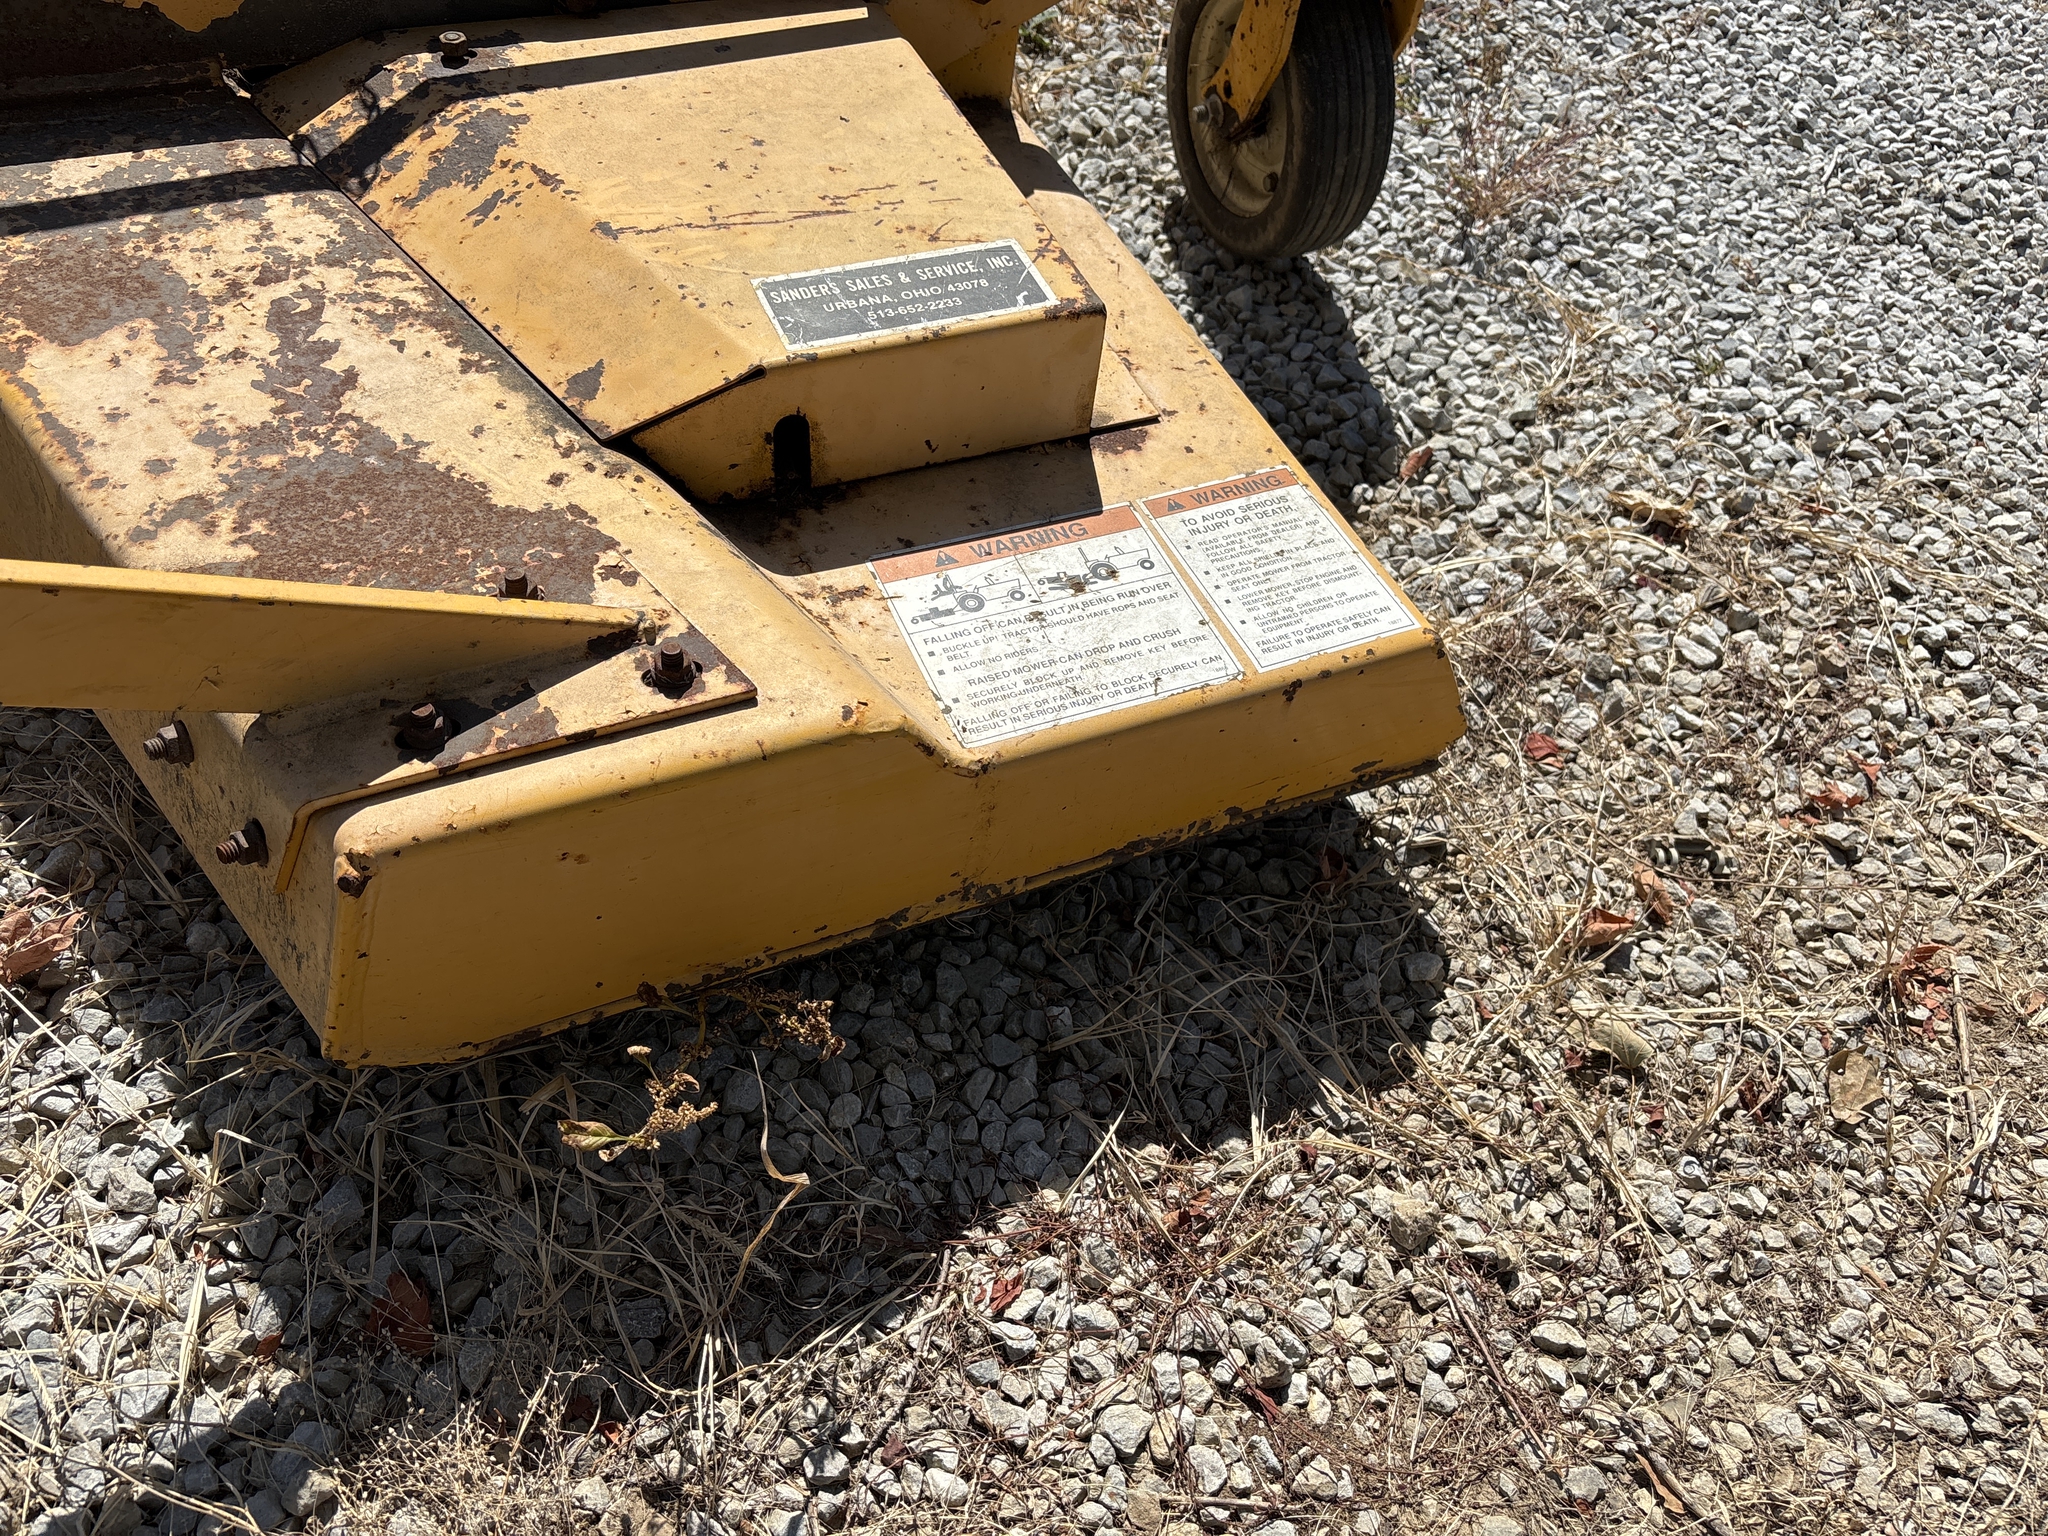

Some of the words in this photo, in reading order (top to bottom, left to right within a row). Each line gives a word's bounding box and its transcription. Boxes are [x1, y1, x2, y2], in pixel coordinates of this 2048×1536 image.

[769, 281, 840, 303] SANDERS
[845, 273, 892, 291] SALES
[897, 271, 911, 283] &
[915, 258, 983, 280] SERVICE,
[822, 294, 897, 312] URBANA,
[900, 286, 941, 299] OHIO
[947, 278, 989, 291] 43078
[867, 297, 962, 321] 513-652-2233
[1188, 475, 1282, 504] WARNING
[1179, 517, 1197, 527] TO
[1201, 508, 1235, 522] AVOID
[1237, 495, 1288, 513] SERIOUS
[1187, 519, 1229, 536] INJURY
[1233, 513, 1252, 524] OR
[968, 522, 1089, 558] WARNING
[1197, 537, 1218, 546] READ
[1221, 524, 1269, 540] OPERATOR'S
[1271, 517, 1302, 527] MANUAL
[1201, 537, 1245, 553] (AVAILABLE
[1247, 531, 1268, 540] FROM
[1269, 523, 1302, 535] DEALER)
[1304, 518, 1319, 526] AND
[1205, 546, 1236, 558] FOLLOW
[1254, 535, 1281, 545] SAFETY
[1215, 563, 1235, 572] KEEP
[1253, 549, 1285, 561] SHIELD
[1320, 537, 1335, 545] AND
[1226, 573, 1261, 586] OPERATE
[1261, 565, 1290, 577] MOWER
[1290, 560, 1312, 569] FROM
[1312, 550, 1346, 563] TRACTOR
[1229, 565, 1252, 575] GOOD
[1230, 583, 1250, 592] SEAT
[1236, 589, 1264, 601] LOWER
[1294, 575, 1313, 585] STOP
[1314, 568, 1341, 580] ENGINE
[1342, 564, 1357, 572] AND
[1241, 594, 1273, 606] REMOVE
[1274, 589, 1289, 597] KEY
[1291, 581, 1321, 593] BEFORE
[1322, 570, 1362, 584] DISMOUNT-
[922, 627, 971, 645] FALLING
[973, 622, 994, 633] OFF
[997, 616, 1022, 627] CAN
[1023, 606, 1064, 622] RSULT
[1067, 602, 1080, 611] IN
[1080, 594, 1115, 608] BEING
[1116, 588, 1140, 599] RUN
[1140, 581, 1172, 593] OVER
[941, 639, 981, 653] BUCKLE
[981, 635, 998, 644] UP!
[1045, 614, 1084, 628] SHOULD
[1085, 608, 1110, 619] HAVE
[1110, 602, 1136, 613] ROPS
[1137, 597, 1156, 607] AND
[1156, 591, 1179, 602] SEAT
[1253, 609, 1279, 621] ALLOW
[1296, 595, 1333, 609] CHILDREN
[1256, 612, 1298, 627] UNTRAINED
[1298, 602, 1334, 615] PERSONS
[1344, 590, 1379, 603] OPERATE
[1255, 632, 1291, 647] FAILURE
[1290, 629, 1303, 637] TO
[1303, 618, 1342, 633] OPERATE
[1341, 610, 1372, 623] SAFELY
[1372, 605, 1391, 614] CAN
[1260, 640, 1292, 654] RESULT
[1305, 628, 1334, 641] INJURY
[1336, 624, 1350, 632] OR
[946, 650, 969, 661] BELT.
[953, 658, 988, 672] ALLOW
[987, 655, 1002, 663] NO
[966, 681, 1017, 700] SECURELY
[1022, 671, 1057, 685] BLOCK
[1060, 667, 1074, 675] UP
[1079, 661, 1101, 672] AND
[1102, 650, 1144, 665] REMOVE
[1147, 644, 1166, 654] KEY
[1170, 634, 1209, 648] BEFORE
[967, 670, 1010, 686] RAISED
[1012, 658, 1056, 675] MOWER
[1058, 651, 1083, 663] CAN
[1084, 643, 1115, 657] DROP
[1118, 637, 1141, 649] AND
[1142, 627, 1181, 642] CRUSH
[962, 709, 1007, 726] FALLING
[1010, 702, 1030, 714] OFF
[1033, 698, 1049, 708] OR
[1052, 687, 1091, 702] FAILING
[1093, 682, 1108, 691] TO
[1110, 673, 1146, 687] BLOCK
[1147, 660, 1197, 678] SECURELY
[1201, 654, 1222, 664] CAN
[970, 691, 1020, 708] WORKING
[965, 718, 1007, 735] RESULT
[1008, 715, 1021, 723] IN
[1022, 701, 1068, 720] SERIOUS
[1068, 693, 1104, 708] INJURY
[1107, 689, 1122, 698] OR
